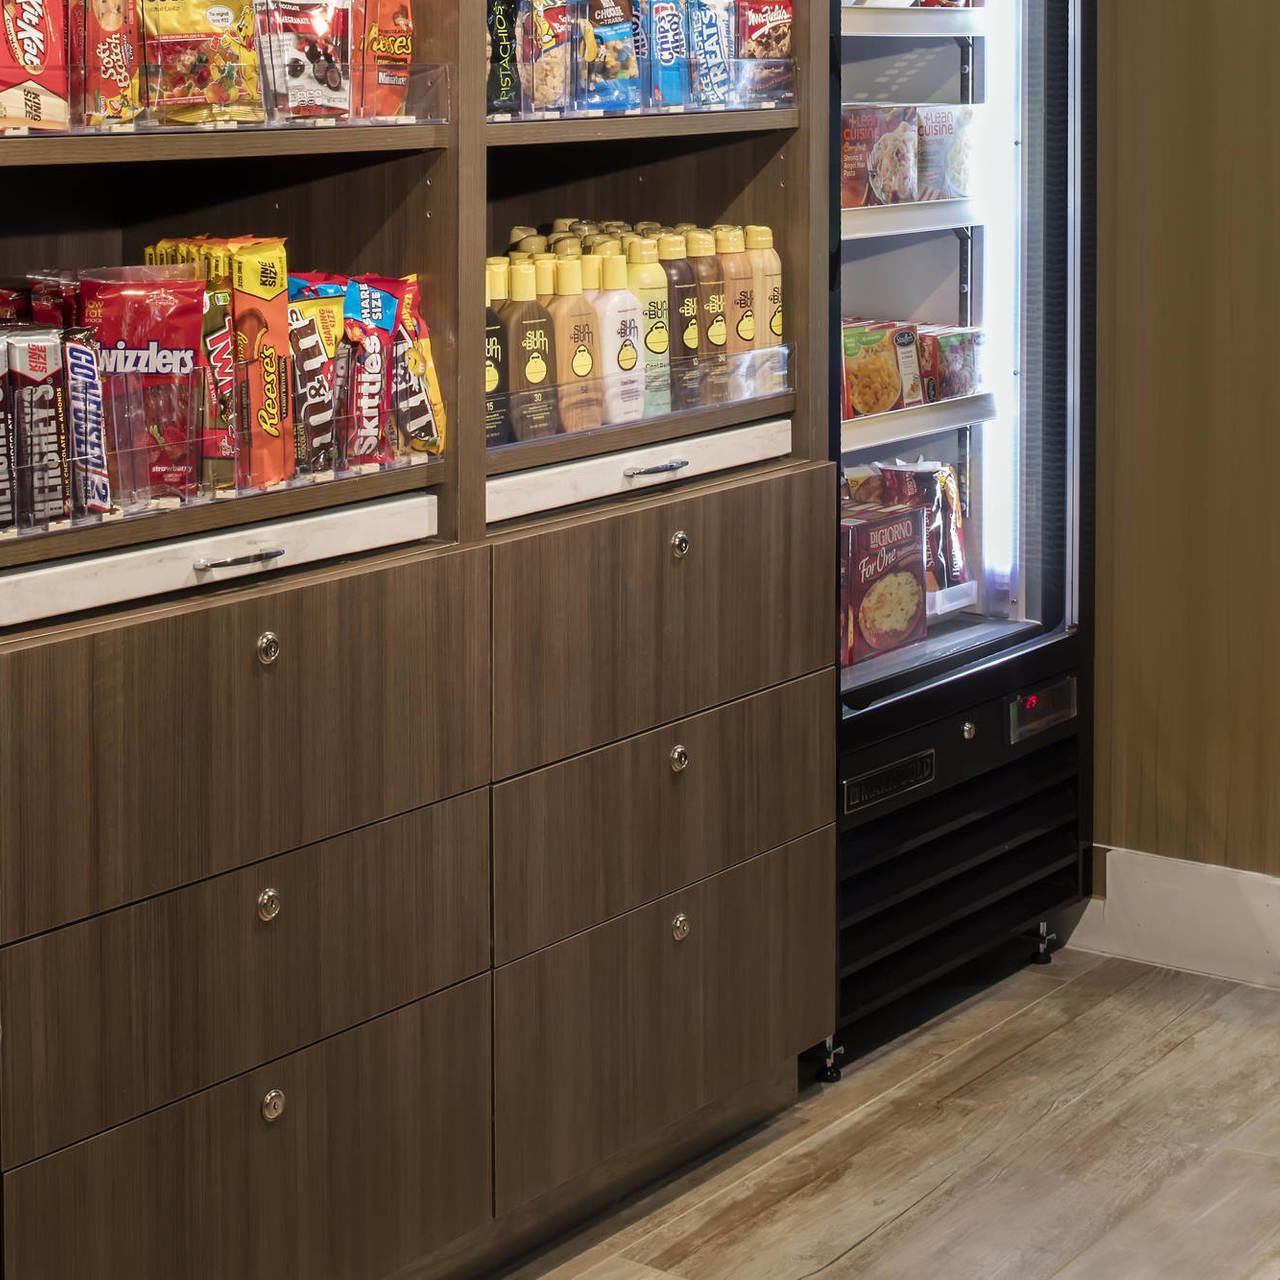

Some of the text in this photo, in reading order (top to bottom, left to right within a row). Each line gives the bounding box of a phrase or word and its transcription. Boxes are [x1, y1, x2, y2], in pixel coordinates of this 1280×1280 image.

[96, 40, 109, 81] Soft
[110, 32, 131, 89] Batch
[495, 1, 513, 101] PISTACHIOS
[702, 9, 732, 104] TREATS
[23, 88, 32, 121] SIZE
[33, 92, 42, 122] KING
[917, 123, 954, 137] cuisine
[371, 291, 383, 321] SIZE
[319, 308, 334, 347] SHARING
[28, 343, 39, 373] KING
[38, 345, 48, 374] SIZE
[97, 341, 194, 374] wizzlers
[206, 317, 234, 392] TWI
[55, 387, 63, 422] ALMONDS
[257, 345, 279, 438] Reese's
[355, 335, 381, 456] Skittles
[91, 481, 108, 504] 2
[858, 547, 897, 583] For One
